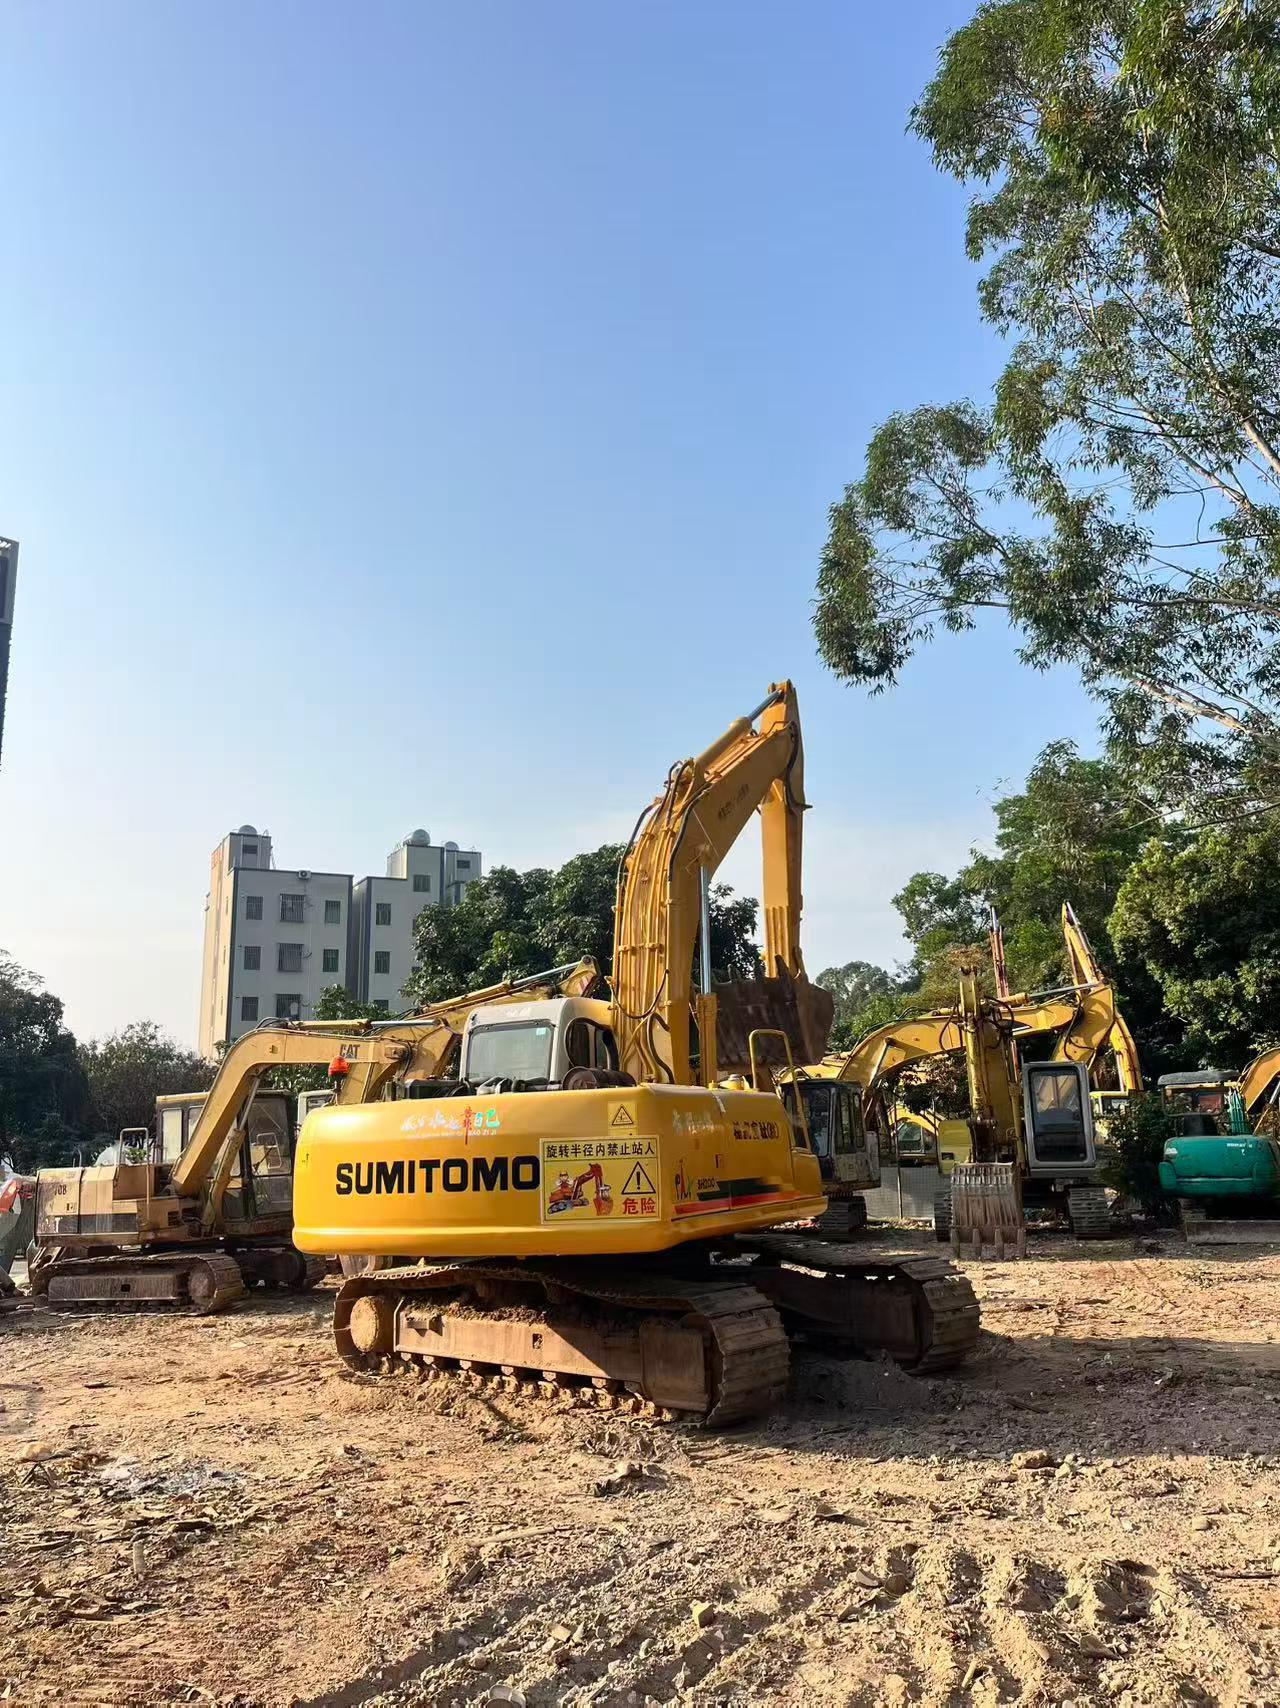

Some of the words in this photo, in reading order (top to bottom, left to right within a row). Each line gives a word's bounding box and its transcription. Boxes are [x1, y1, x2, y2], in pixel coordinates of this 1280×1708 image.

[340, 1044, 360, 1059] CAT
[546, 1142, 655, 1158] 旋转半径内禁止站人
[336, 1156, 540, 1195] SUMITOMO
[622, 1198, 656, 1214] 危险
